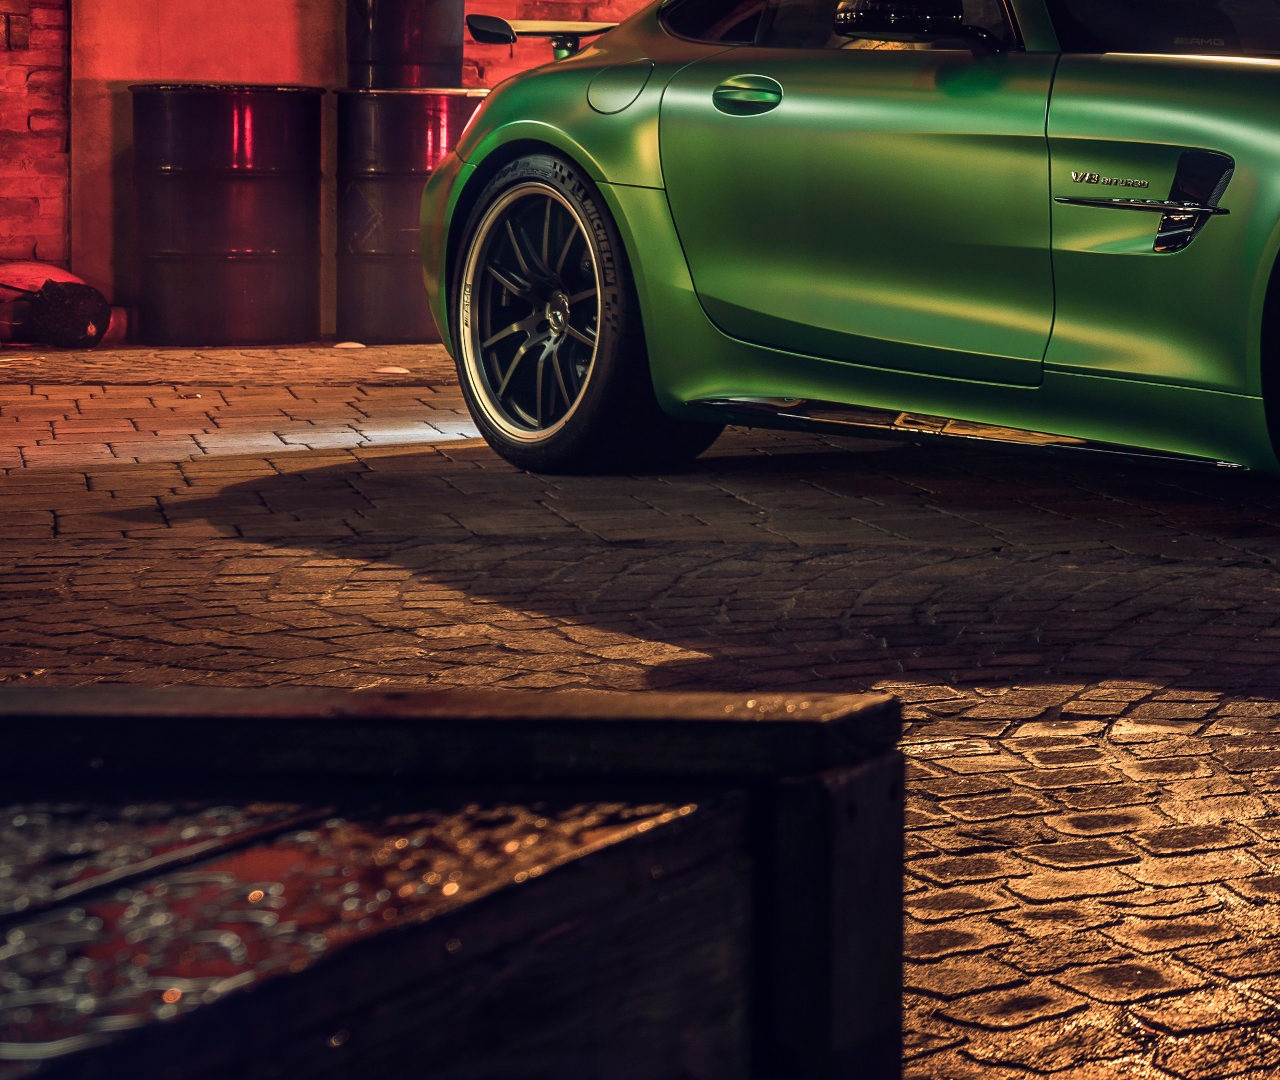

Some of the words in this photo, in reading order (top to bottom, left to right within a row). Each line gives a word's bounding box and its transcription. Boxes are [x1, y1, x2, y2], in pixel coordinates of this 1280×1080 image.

[1071, 171, 1100, 184] V8
[1101, 176, 1149, 189] BITURBO
[583, 198, 617, 288] MICHELIN
